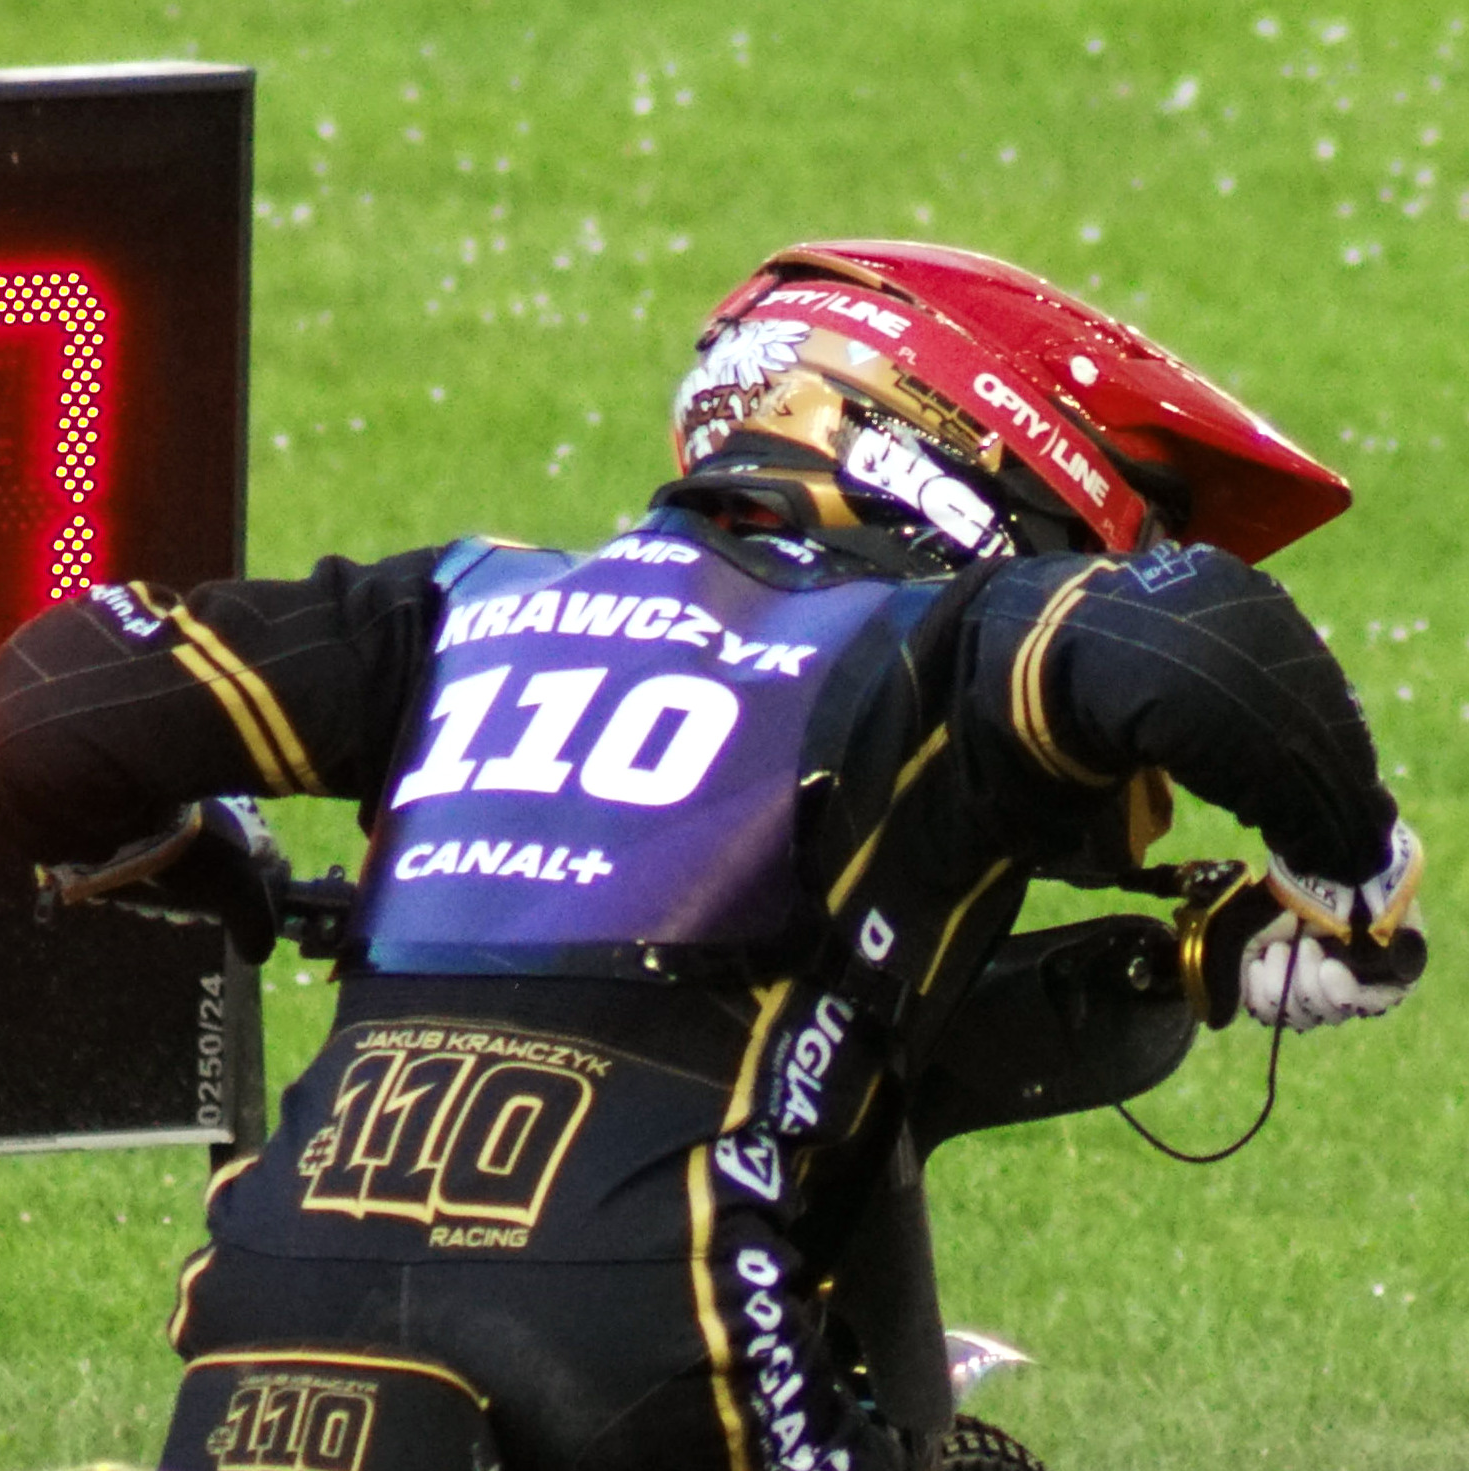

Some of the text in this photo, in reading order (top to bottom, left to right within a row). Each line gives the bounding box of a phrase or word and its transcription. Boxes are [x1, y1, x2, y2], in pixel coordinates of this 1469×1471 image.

[973, 372, 1111, 508] OPTY LINE
[434, 590, 817, 677] KRAWCZYK
[391, 664, 740, 810] 110
[393, 839, 613, 884] CANAL+
[196, 973, 224, 1127] 0250/24
[355, 1029, 614, 1078] JAKUB KRAWCZYK
[770, 907, 896, 1137] DUGLA
[430, 1226, 530, 1249] RACING
